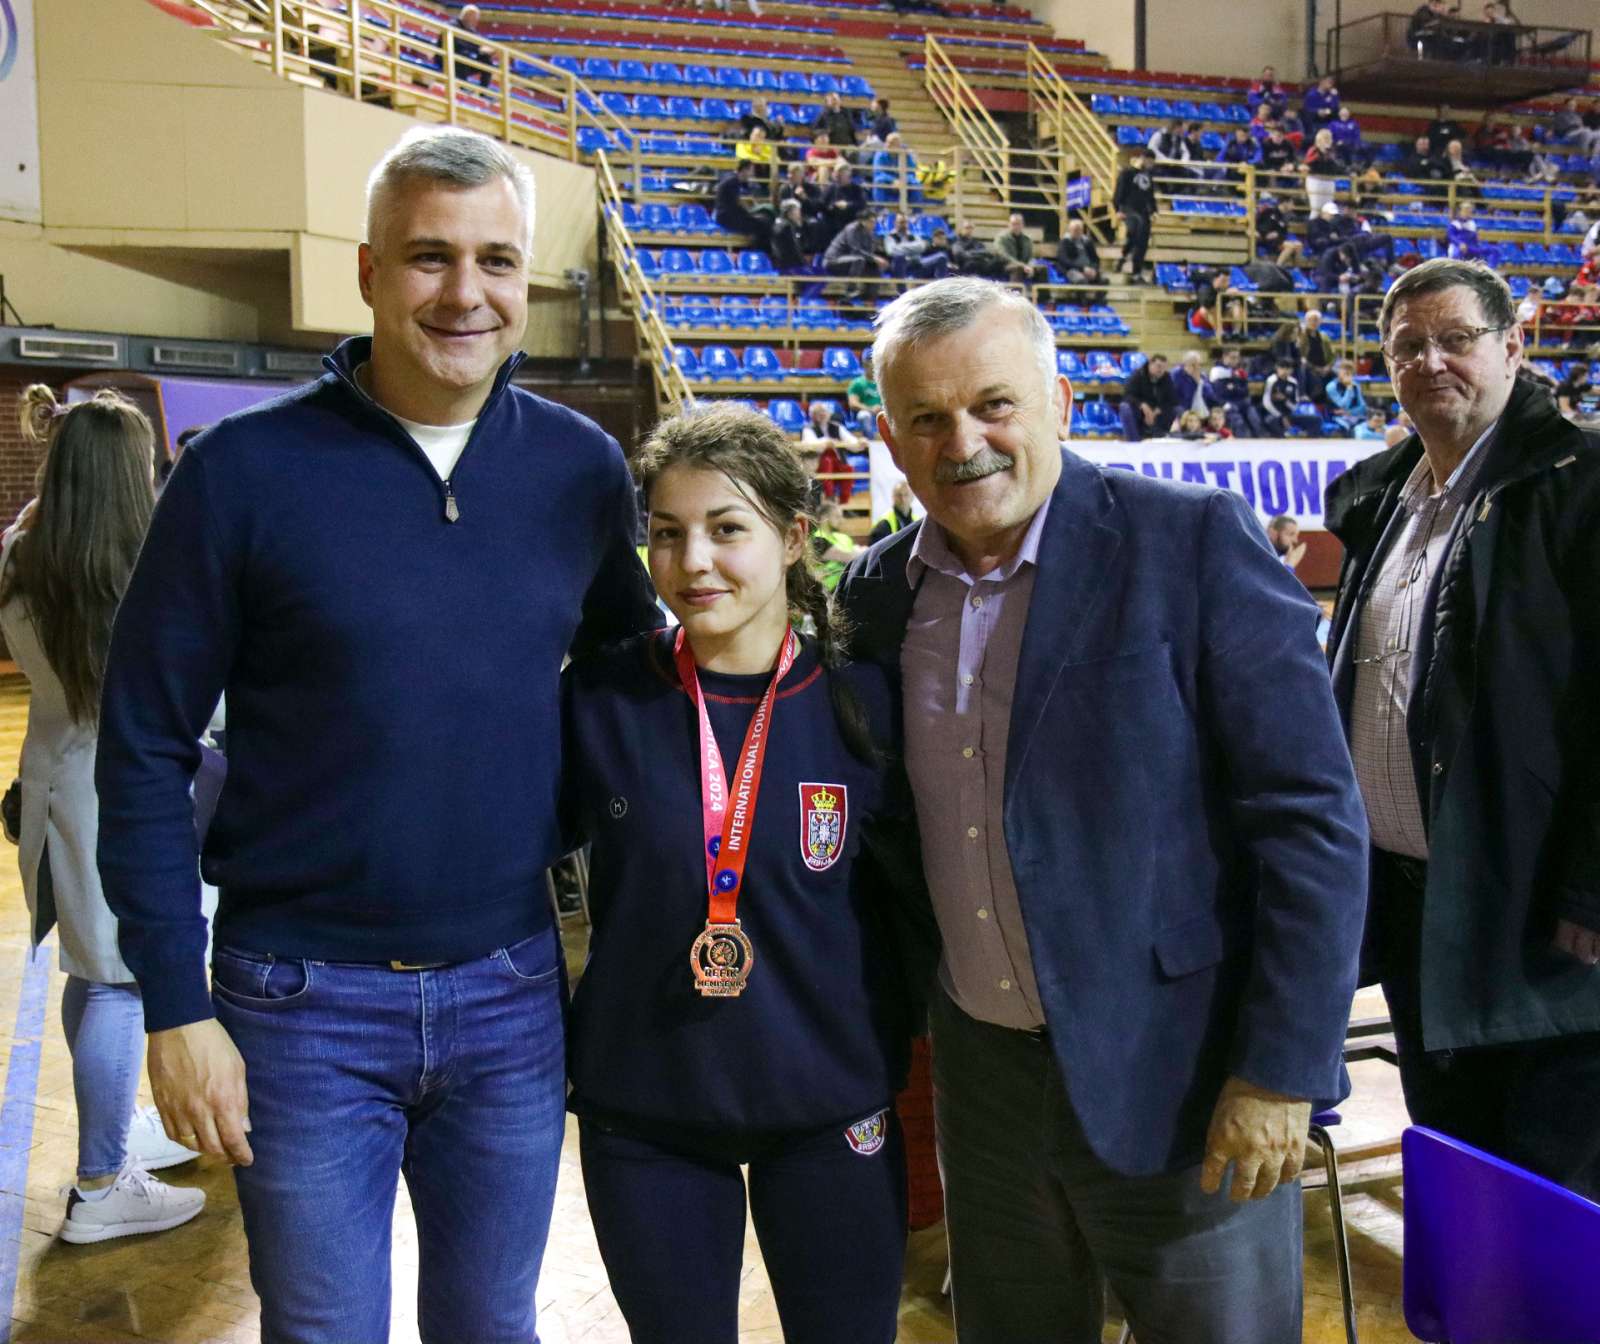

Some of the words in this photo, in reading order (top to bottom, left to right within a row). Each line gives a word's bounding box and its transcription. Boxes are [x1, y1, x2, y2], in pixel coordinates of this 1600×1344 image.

[709, 772, 723, 812] 2024
[728, 742, 759, 850] INTERNATIONAL
[704, 967, 738, 977] REFIK
